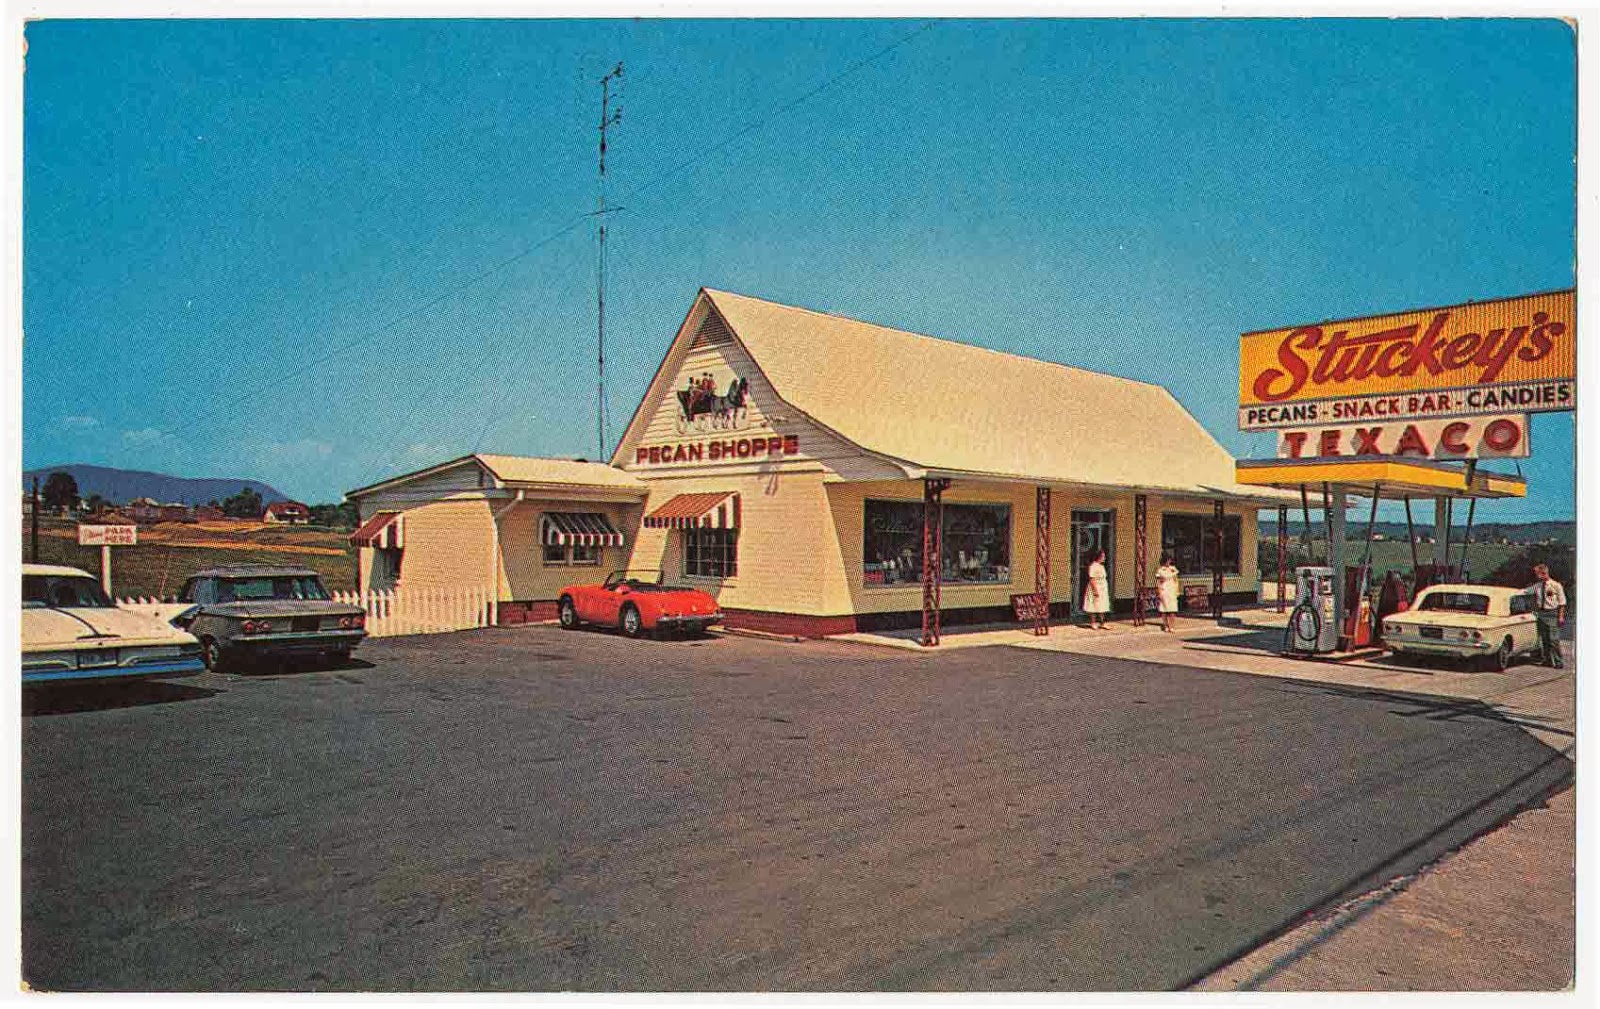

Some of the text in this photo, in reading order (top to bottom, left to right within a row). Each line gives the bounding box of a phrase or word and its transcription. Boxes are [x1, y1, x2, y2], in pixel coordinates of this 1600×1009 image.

[1253, 311, 1567, 402] Stuckey's
[1247, 404, 1318, 425] PECANS
[1333, 399, 1400, 420] SNACK
[1408, 395, 1451, 414] BAR
[1467, 384, 1571, 409] CANDIES
[635, 434, 799, 464] PECAN SHOPPE
[1284, 418, 1522, 459] TEXACO
